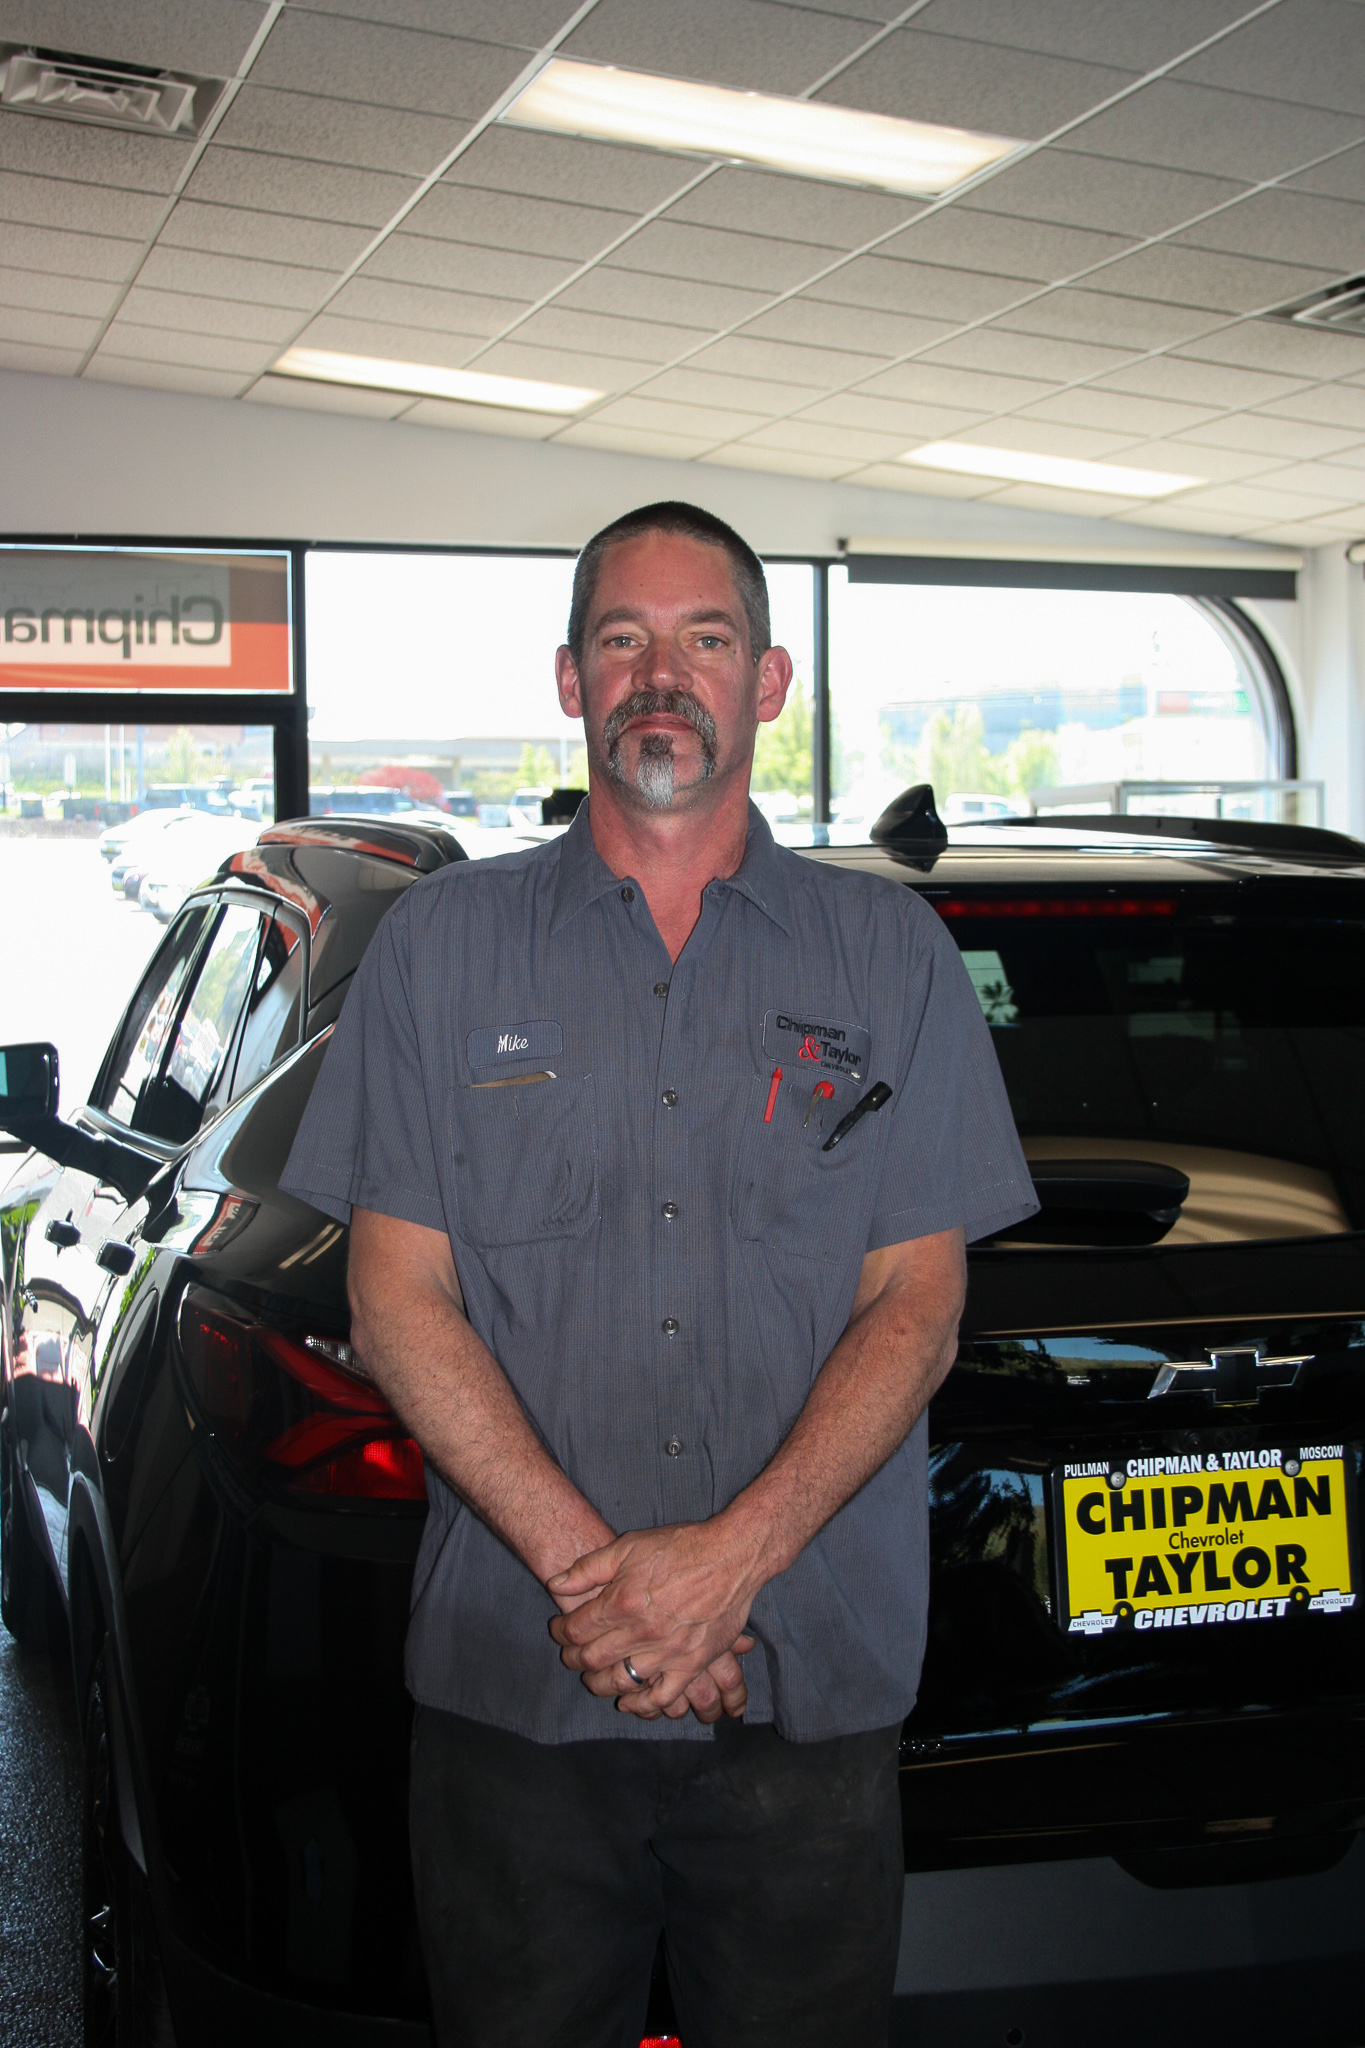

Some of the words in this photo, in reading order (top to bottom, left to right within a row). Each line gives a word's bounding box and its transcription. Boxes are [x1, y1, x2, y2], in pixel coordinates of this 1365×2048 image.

[776, 1014, 846, 1042] Chipman
[497, 1033, 529, 1053] Mike
[798, 1035, 821, 1062] &
[820, 1041, 861, 1066] Taylor
[1126, 1455, 1202, 1477] CHIPMAN
[1206, 1454, 1219, 1471] &
[1222, 1449, 1282, 1470] TAYLOR
[1299, 1445, 1343, 1460] MOSCOW
[1064, 1461, 1109, 1477] PULLMAN
[1076, 1475, 1332, 1535] CHIPMAN
[1168, 1527, 1244, 1550] Chevrolet
[1104, 1543, 1311, 1600] TAYLOR
[1133, 1598, 1291, 1630] CHEVROLET
[1311, 1597, 1352, 1607] CHEVROLET
[1072, 1618, 1113, 1628] CHEVROLET
